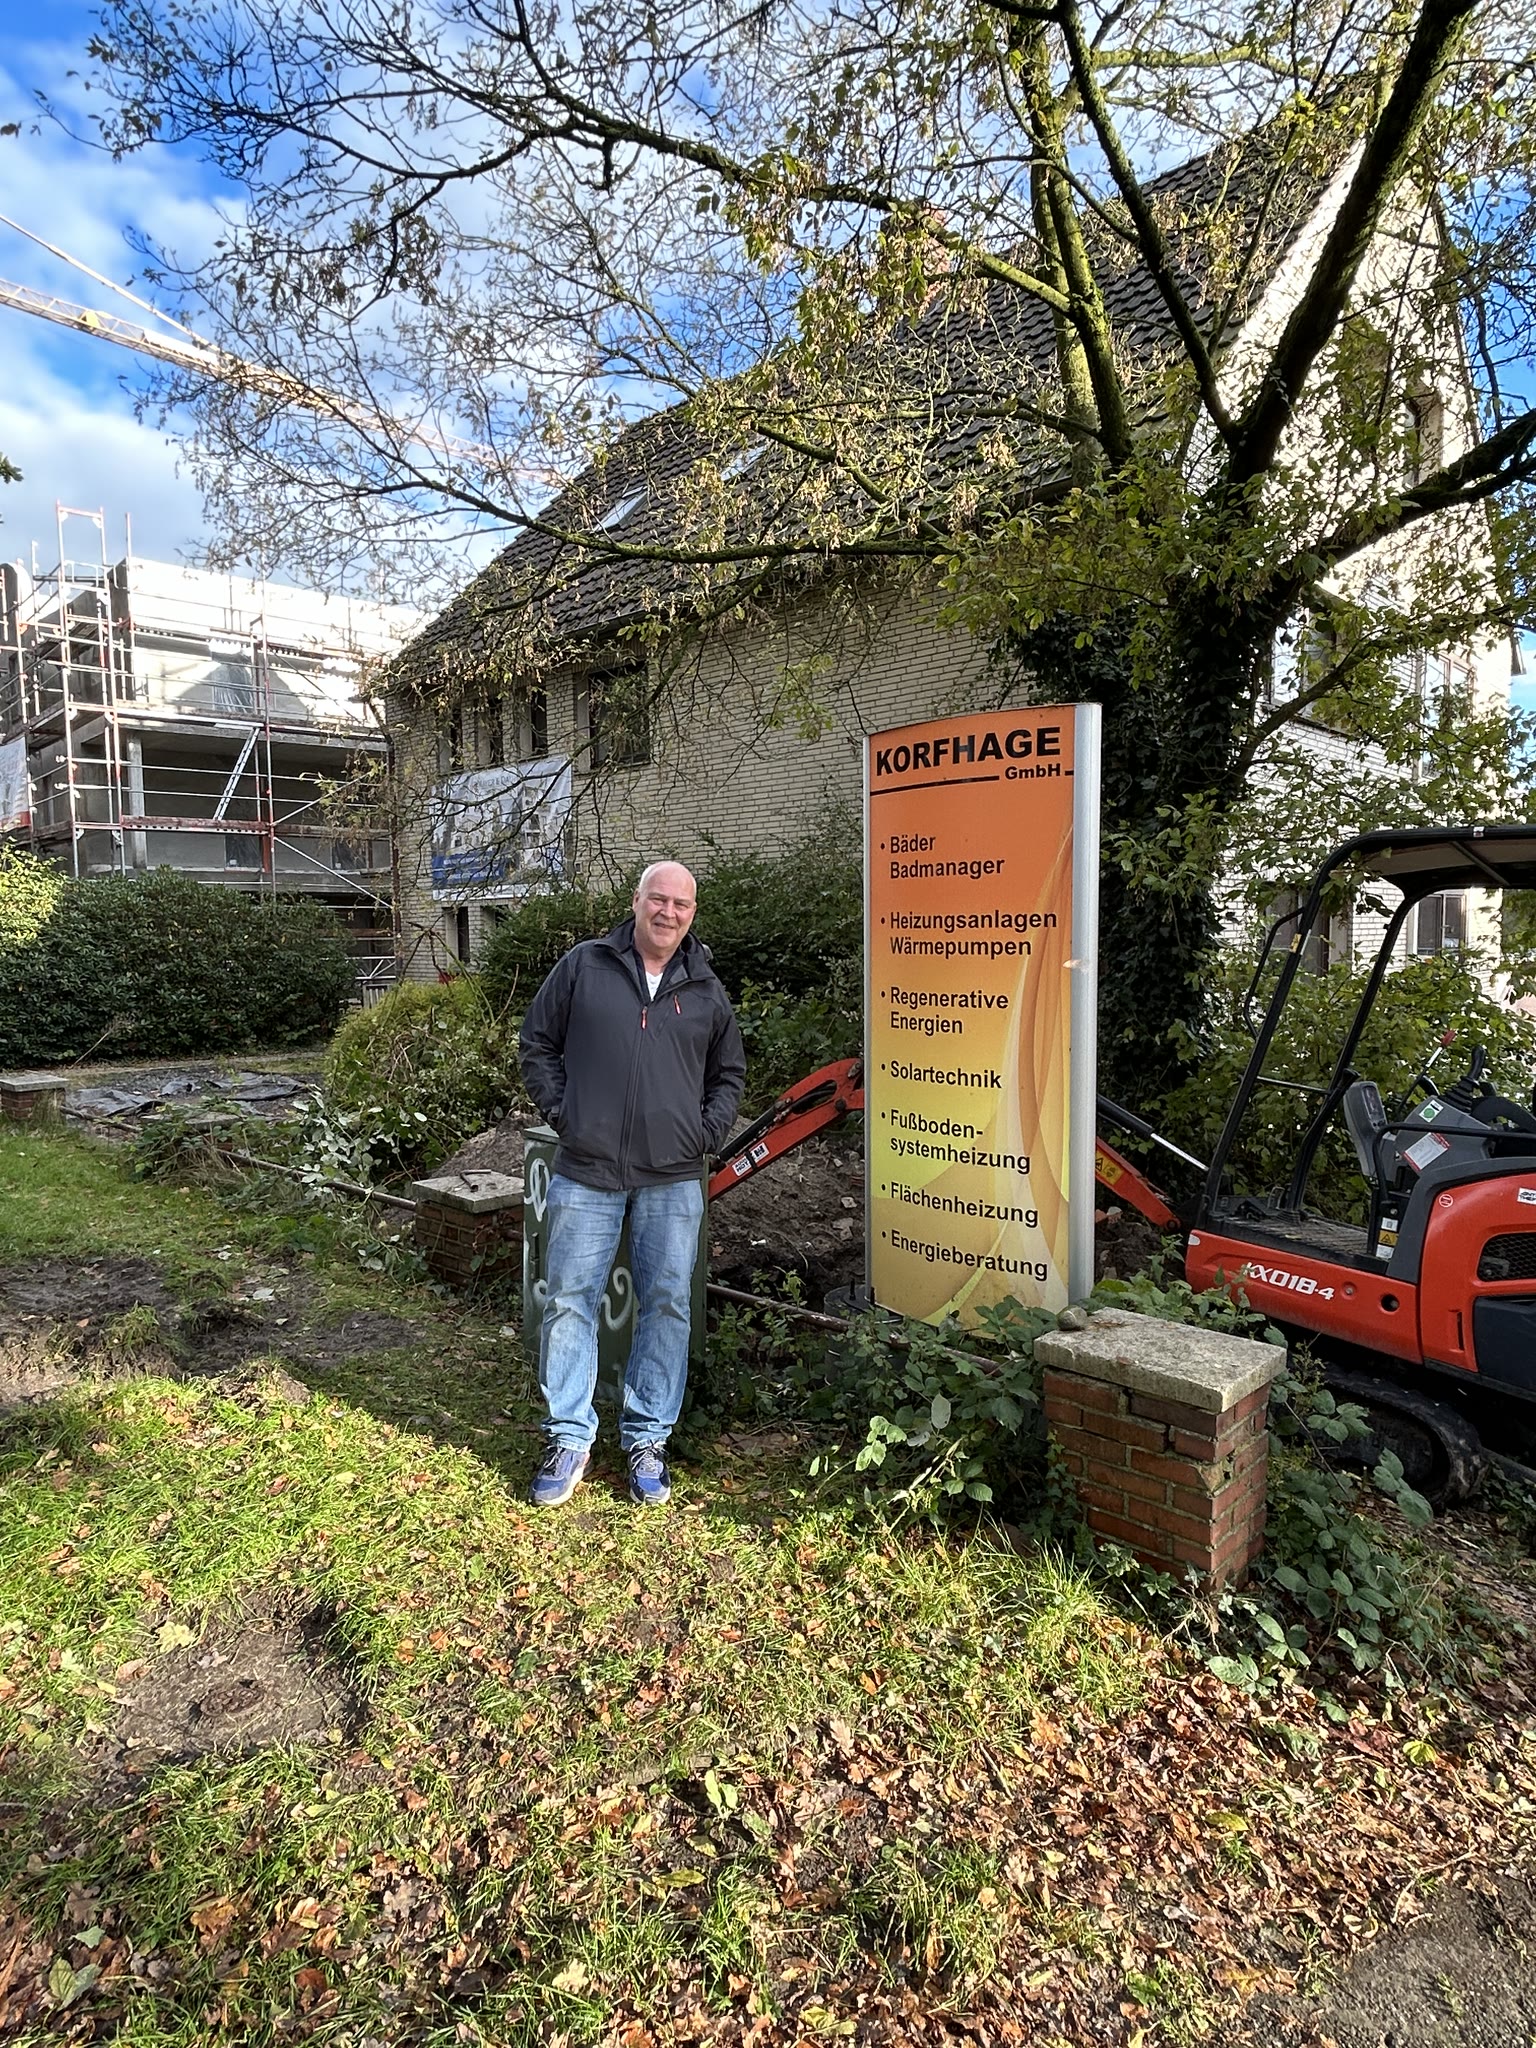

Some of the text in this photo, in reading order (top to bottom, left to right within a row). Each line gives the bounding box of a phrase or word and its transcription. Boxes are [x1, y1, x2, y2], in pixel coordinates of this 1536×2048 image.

[876, 727, 1061, 776] KORFHAGE
[1004, 763, 1062, 780] GmbH
[890, 834, 936, 854] Bäder
[890, 858, 1005, 879] Badmanager
[890, 910, 1057, 933] Heizungsanlagen
[890, 936, 1032, 960] Wärmepumpen
[890, 986, 1009, 1010] Regenerative
[890, 1011, 963, 1036] Energien
[890, 1060, 1002, 1089] Solartechnik
[890, 1109, 983, 1139] Fußboden-
[890, 1136, 1031, 1175] systemheizung
[890, 1181, 1039, 1228] Flächenheizung
[891, 1229, 1048, 1281] Energieberatung
